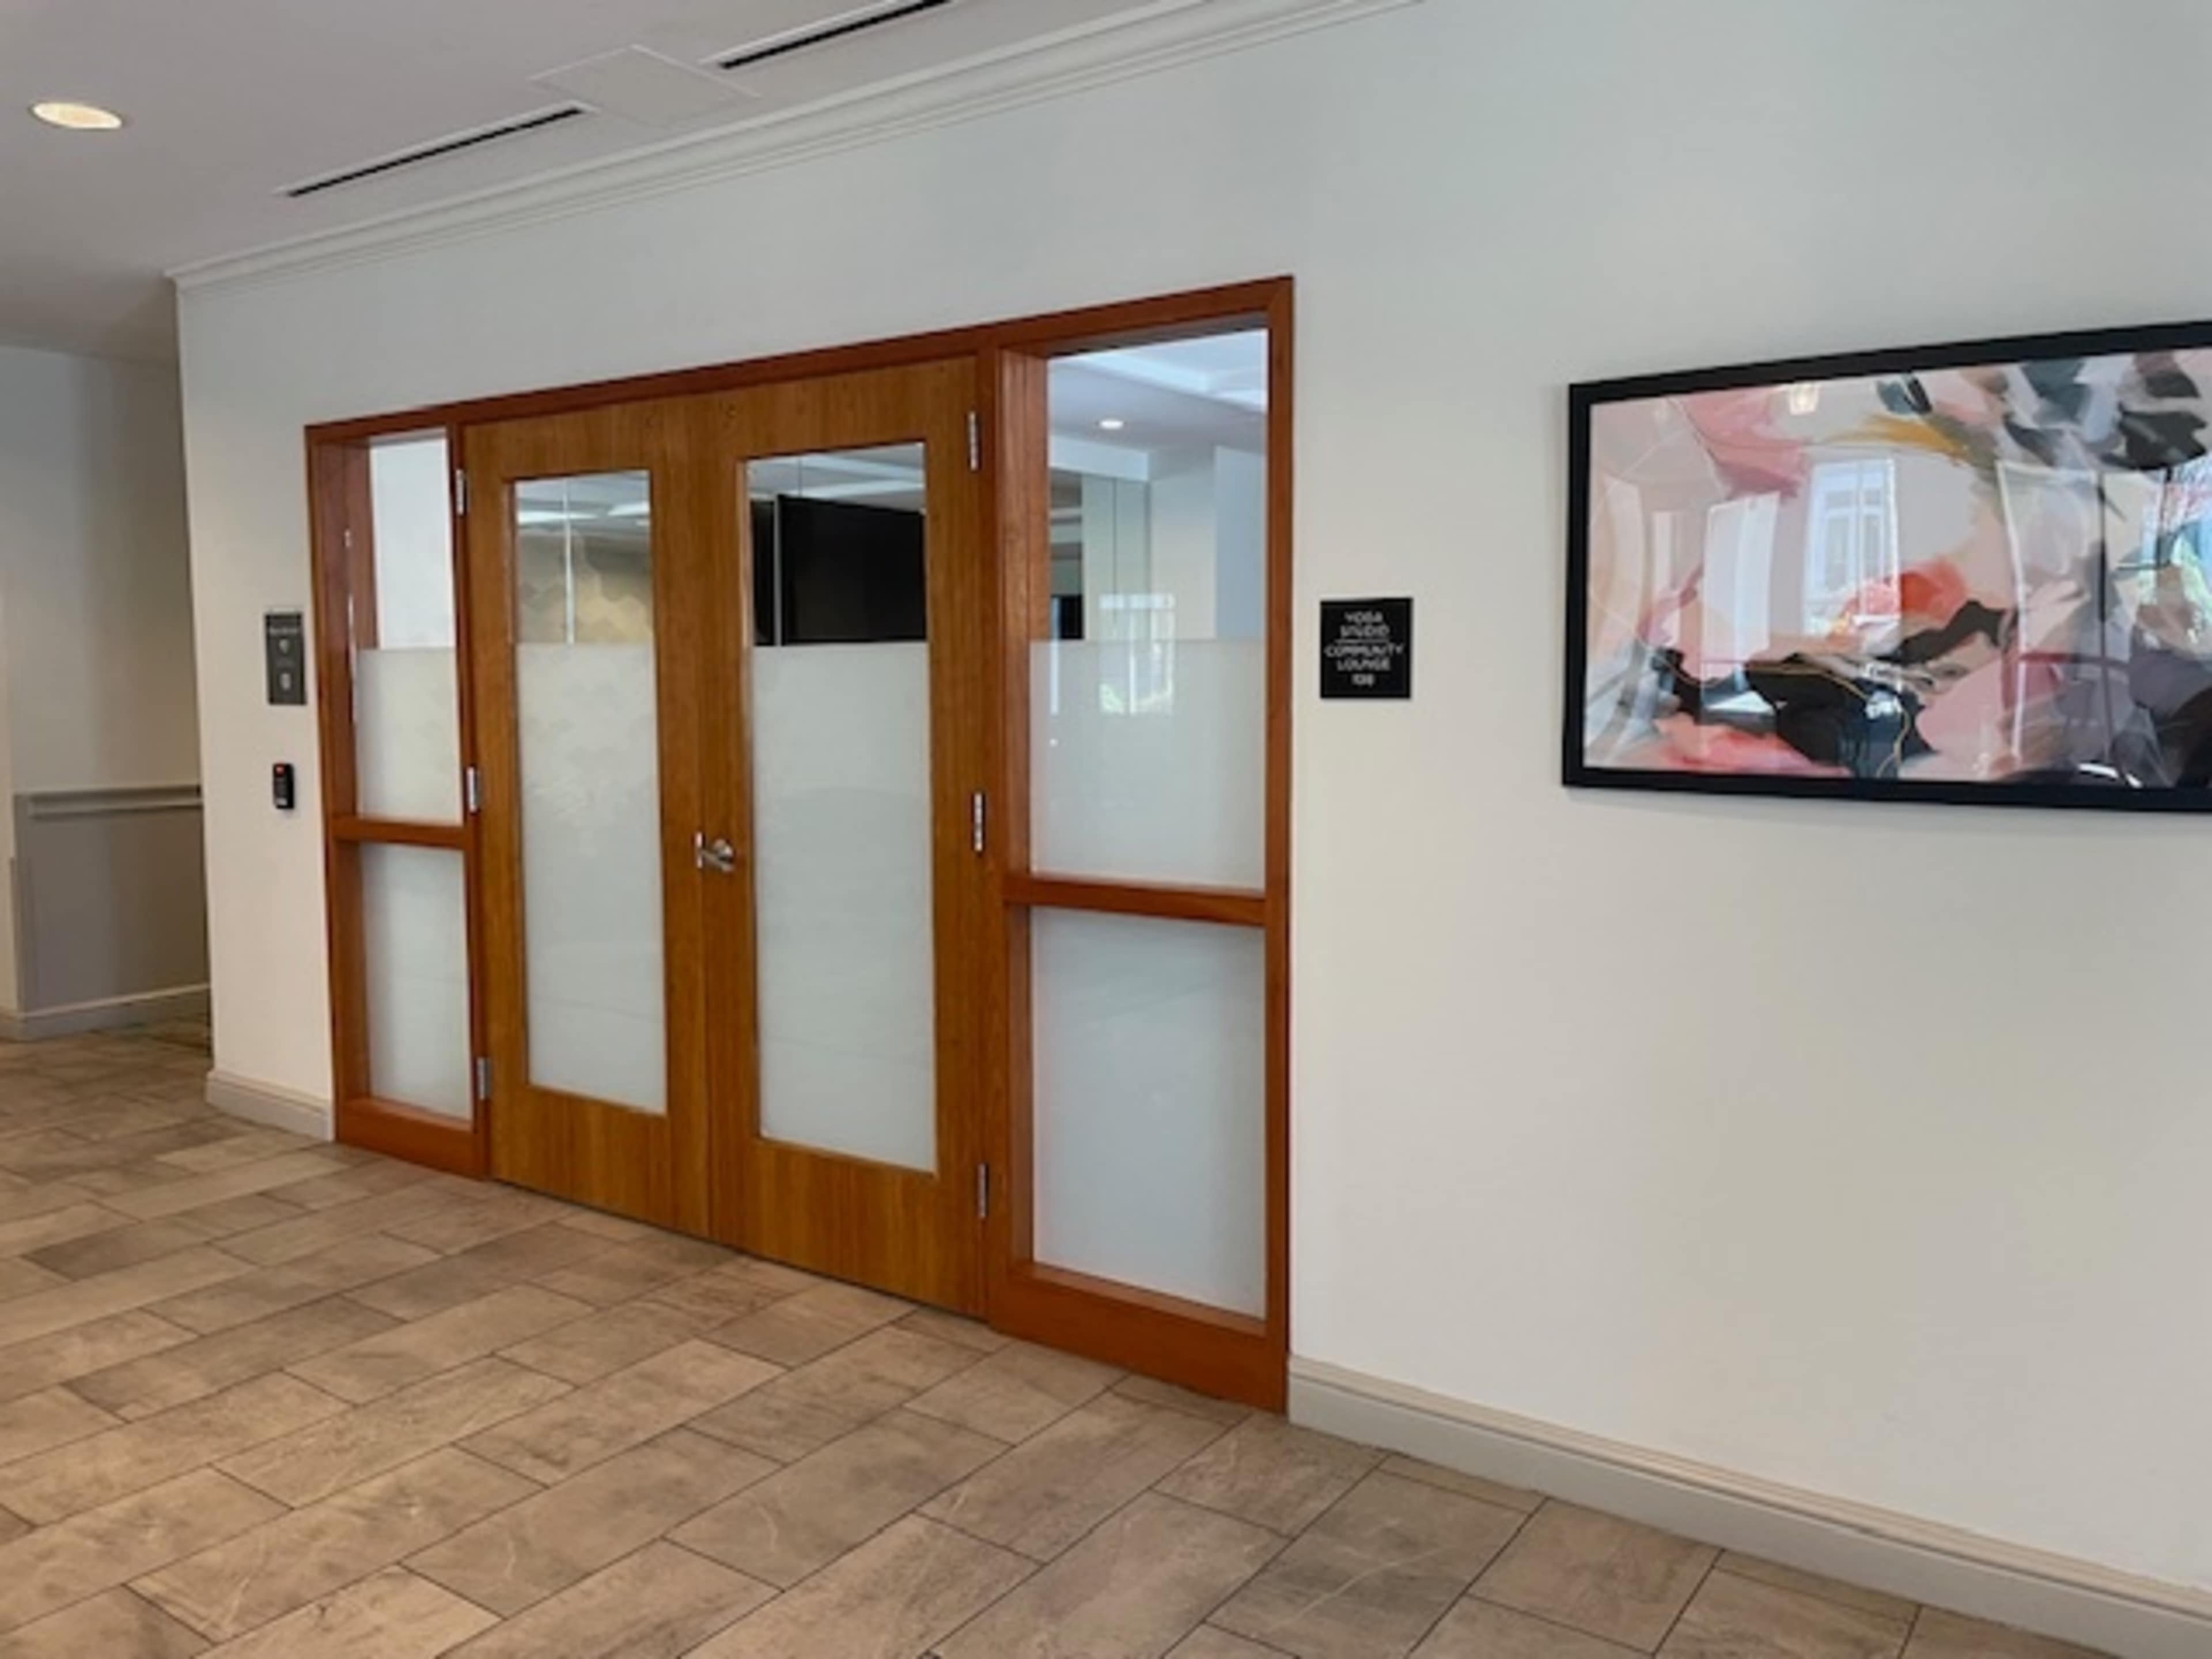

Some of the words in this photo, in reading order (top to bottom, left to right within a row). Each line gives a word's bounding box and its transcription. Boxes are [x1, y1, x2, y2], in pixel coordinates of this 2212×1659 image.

[1344, 611, 1383, 624] YOGA
[1323, 643, 1404, 658] COMMUNITY
[1336, 658, 1391, 672] LOUNGE
